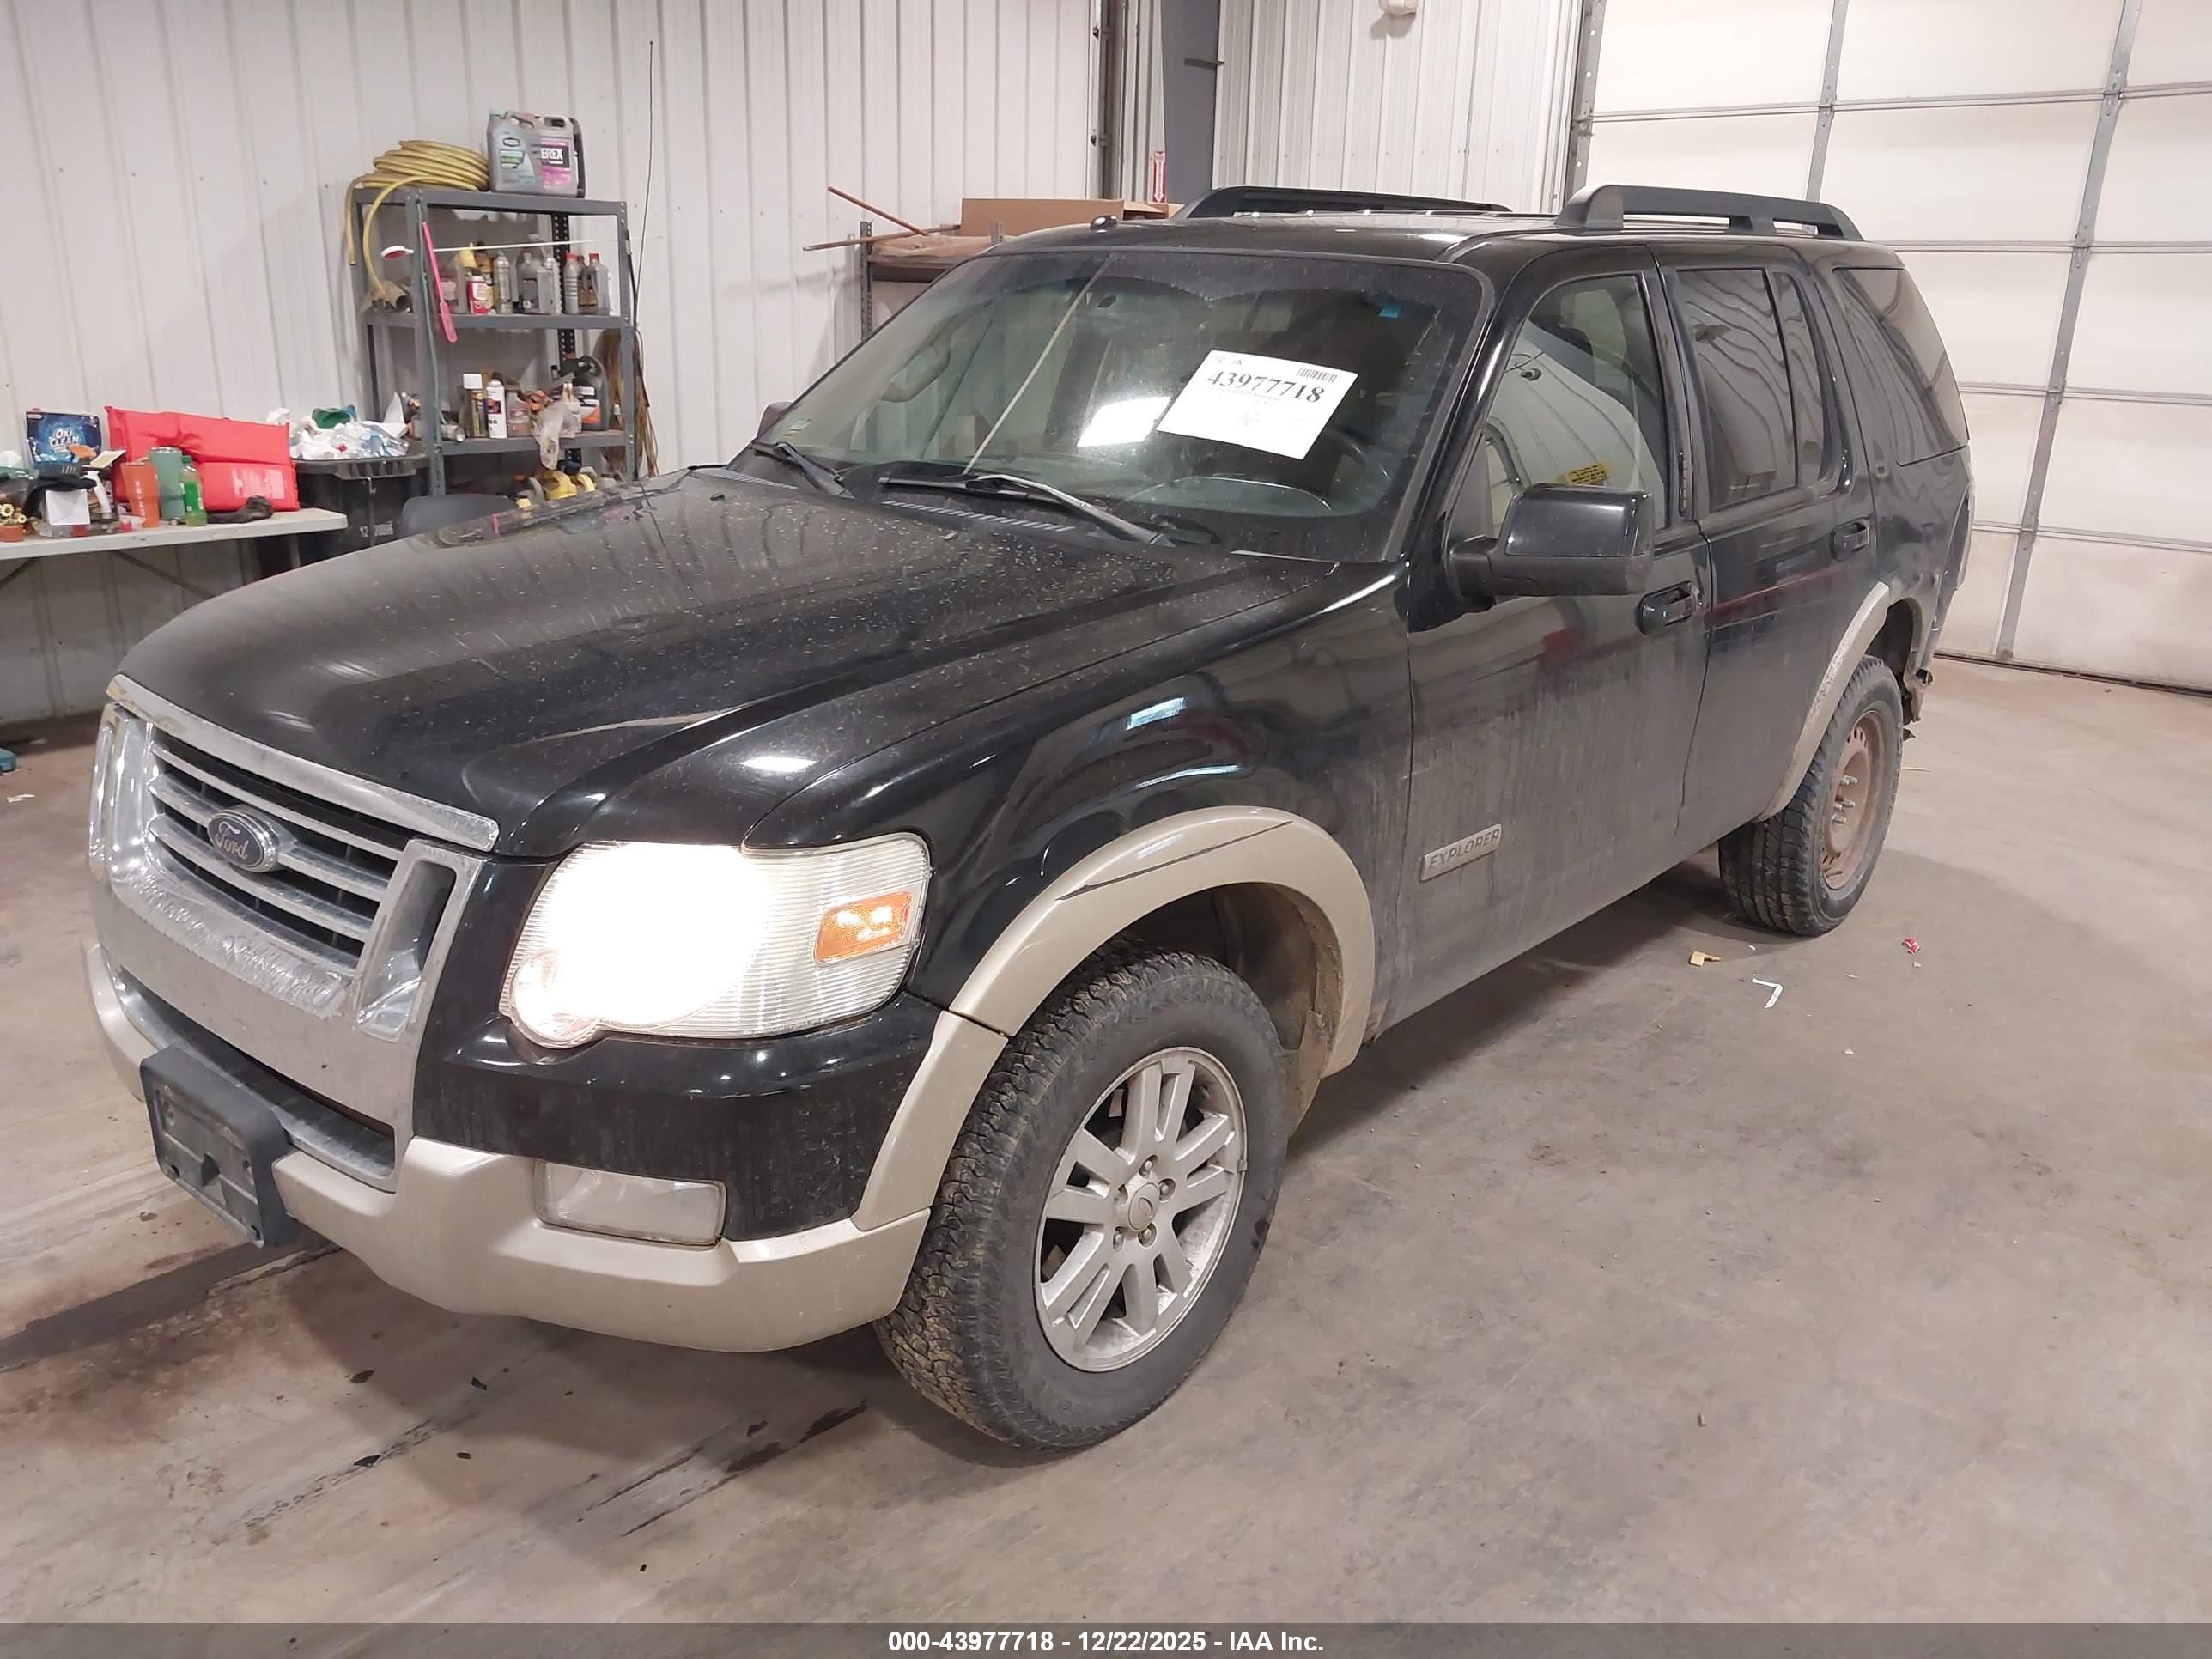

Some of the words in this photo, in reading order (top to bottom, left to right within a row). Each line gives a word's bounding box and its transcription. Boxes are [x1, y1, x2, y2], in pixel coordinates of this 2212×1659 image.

[541, 148, 564, 161] EREX
[1207, 370, 1325, 403] 43977718
[49, 436, 80, 447] CLEAN
[55, 428, 73, 439] OXI
[215, 822, 249, 860] Ford
[1429, 829, 1499, 869] EXPLORER
